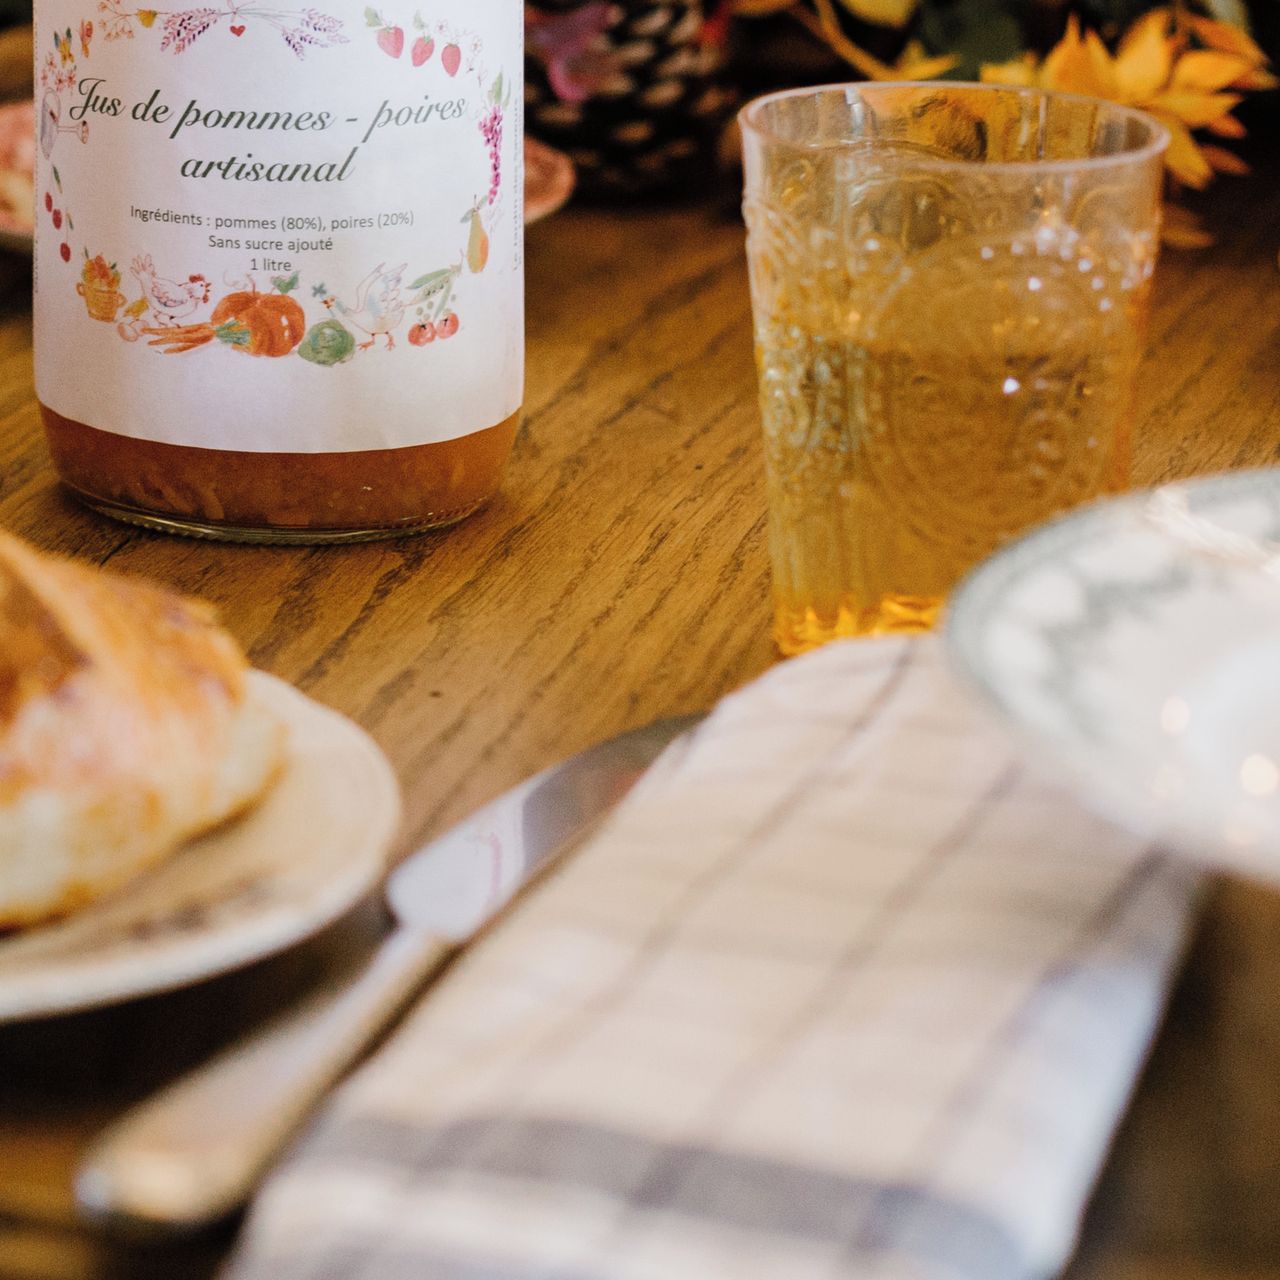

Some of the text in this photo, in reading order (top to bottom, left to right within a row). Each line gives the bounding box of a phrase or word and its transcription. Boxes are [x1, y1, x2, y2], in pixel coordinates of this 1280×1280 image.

[69, 77, 127, 121] Jus
[131, 89, 174, 124] de
[169, 99, 337, 140] pommes
[361, 94, 470, 144] poires
[180, 146, 358, 182] artisanal
[130, 206, 203, 226] Ingrédients
[215, 217, 277, 230] pommes
[281, 216, 327, 232] (80%),
[331, 215, 374, 231] poires
[377, 210, 414, 229] (20%)
[208, 235, 333, 253] Sans sucre ajouté
[250, 258, 292, 271] 1 litre
